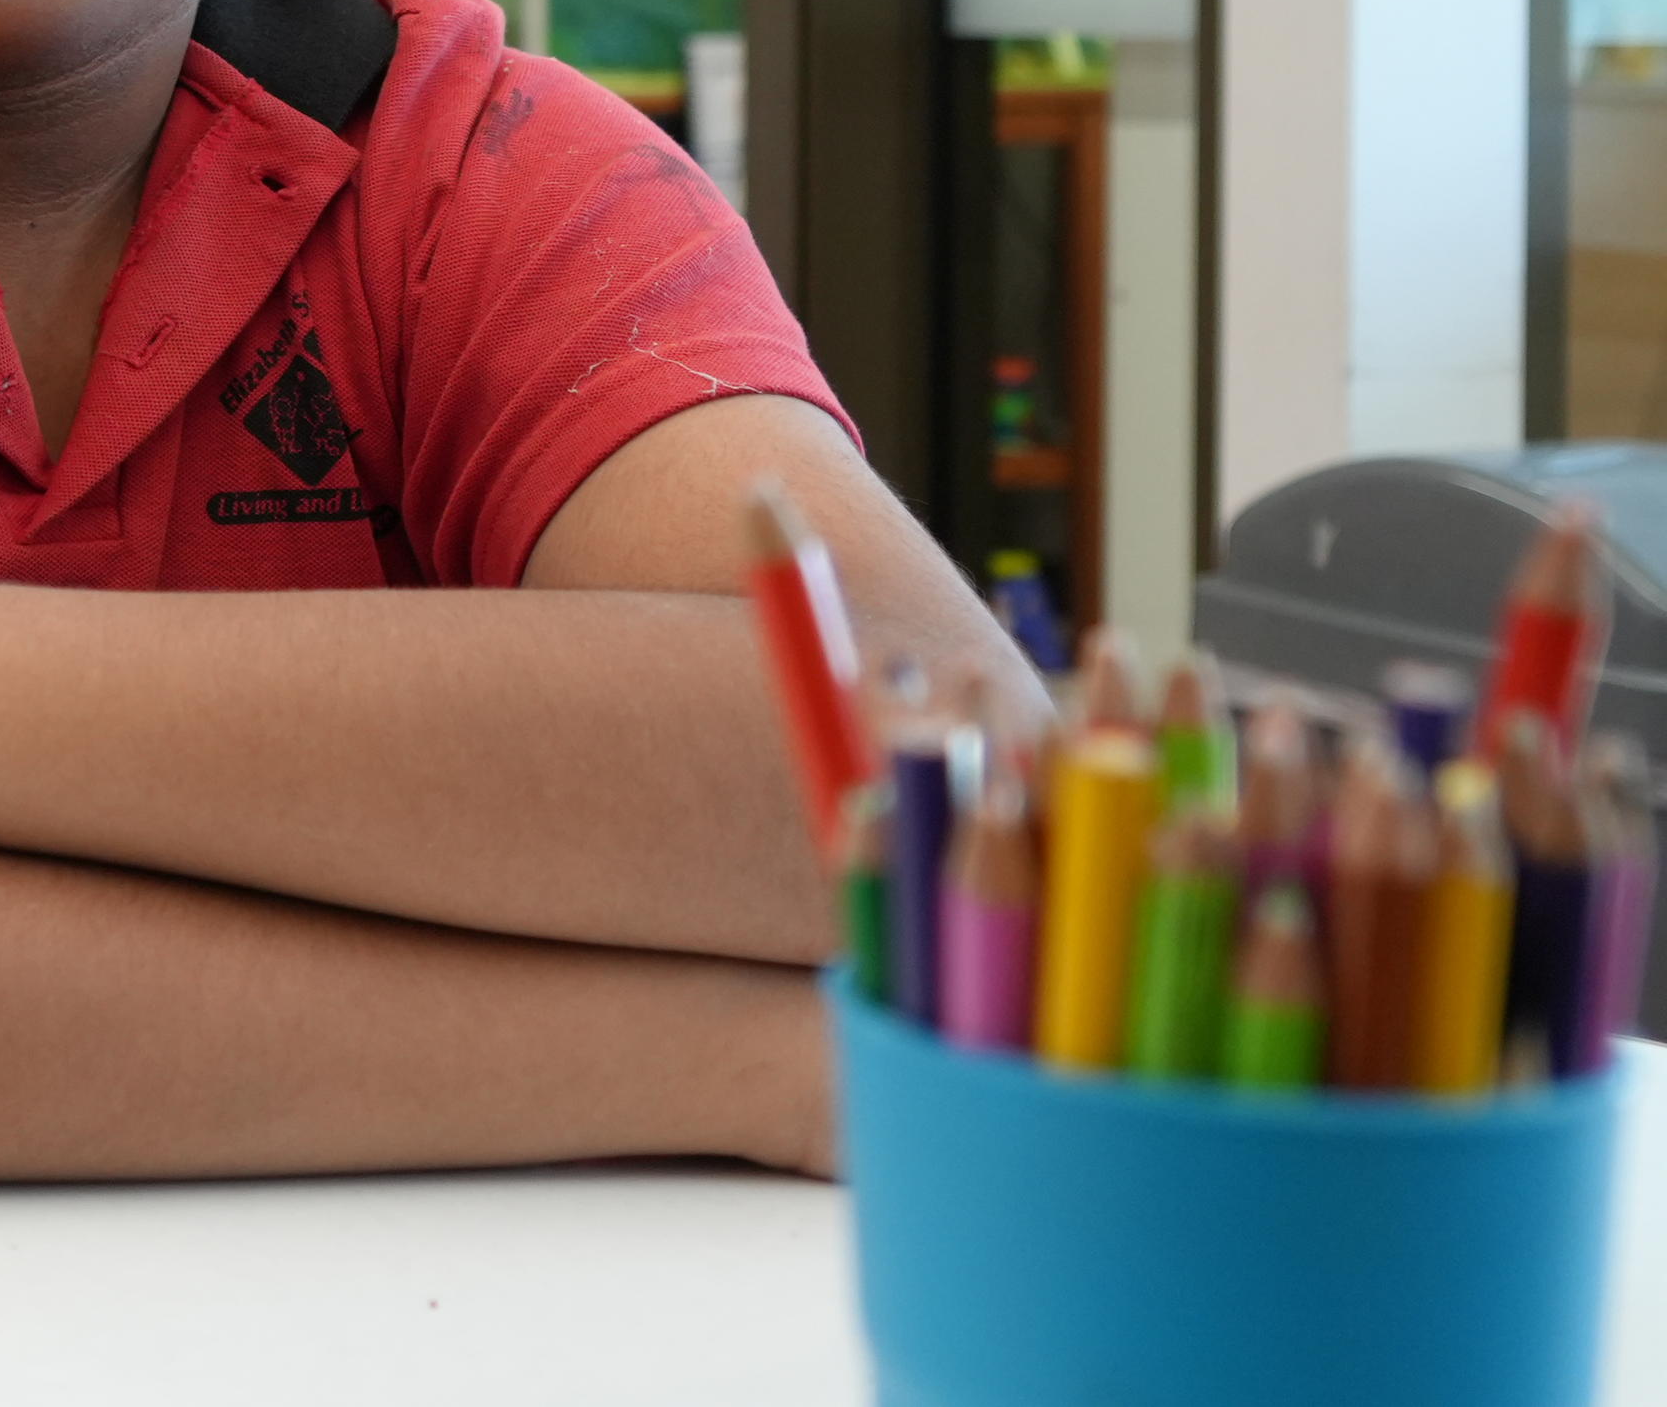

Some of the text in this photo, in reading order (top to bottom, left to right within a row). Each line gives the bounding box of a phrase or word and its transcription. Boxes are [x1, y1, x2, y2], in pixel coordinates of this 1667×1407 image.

[219, 318, 299, 415] Elizabeth
[217, 492, 289, 520] Living
[296, 490, 342, 514] and
